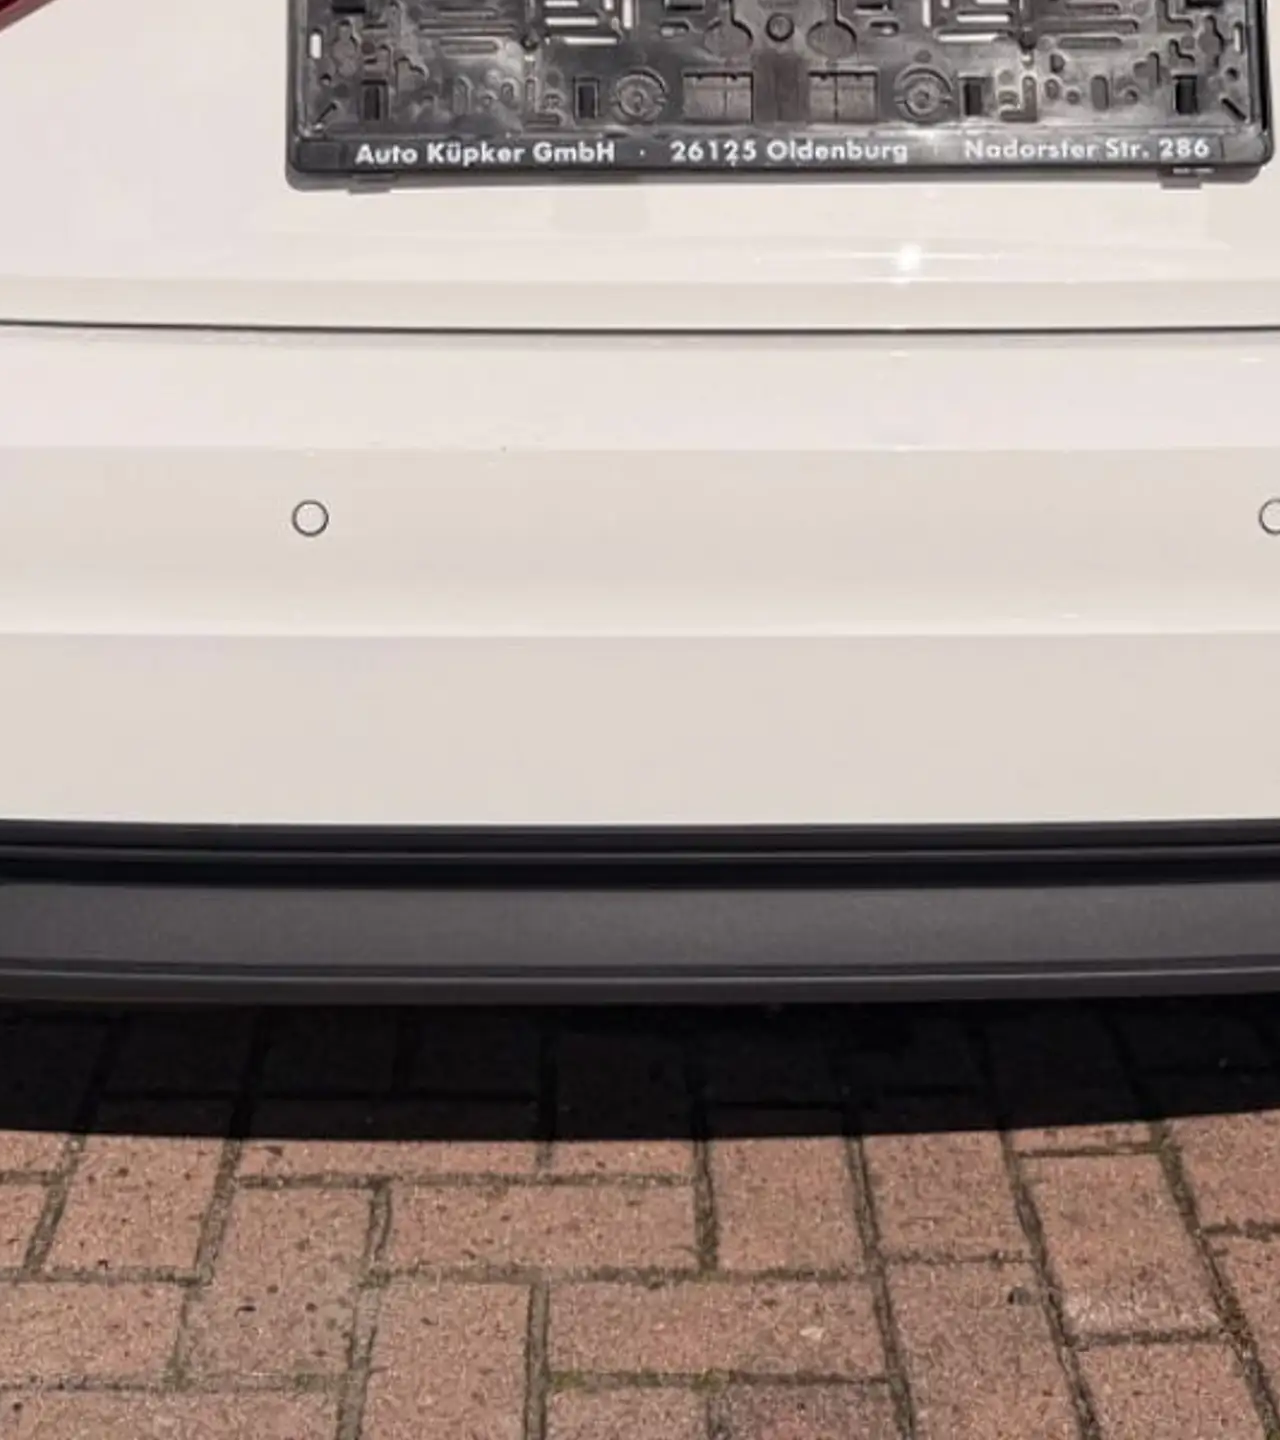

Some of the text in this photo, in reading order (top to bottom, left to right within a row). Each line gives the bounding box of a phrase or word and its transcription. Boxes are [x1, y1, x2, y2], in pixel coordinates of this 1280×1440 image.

[354, 137, 1211, 168] Auto Küpker GmbH 26125 Oldenburg Nadorster Str. 286
